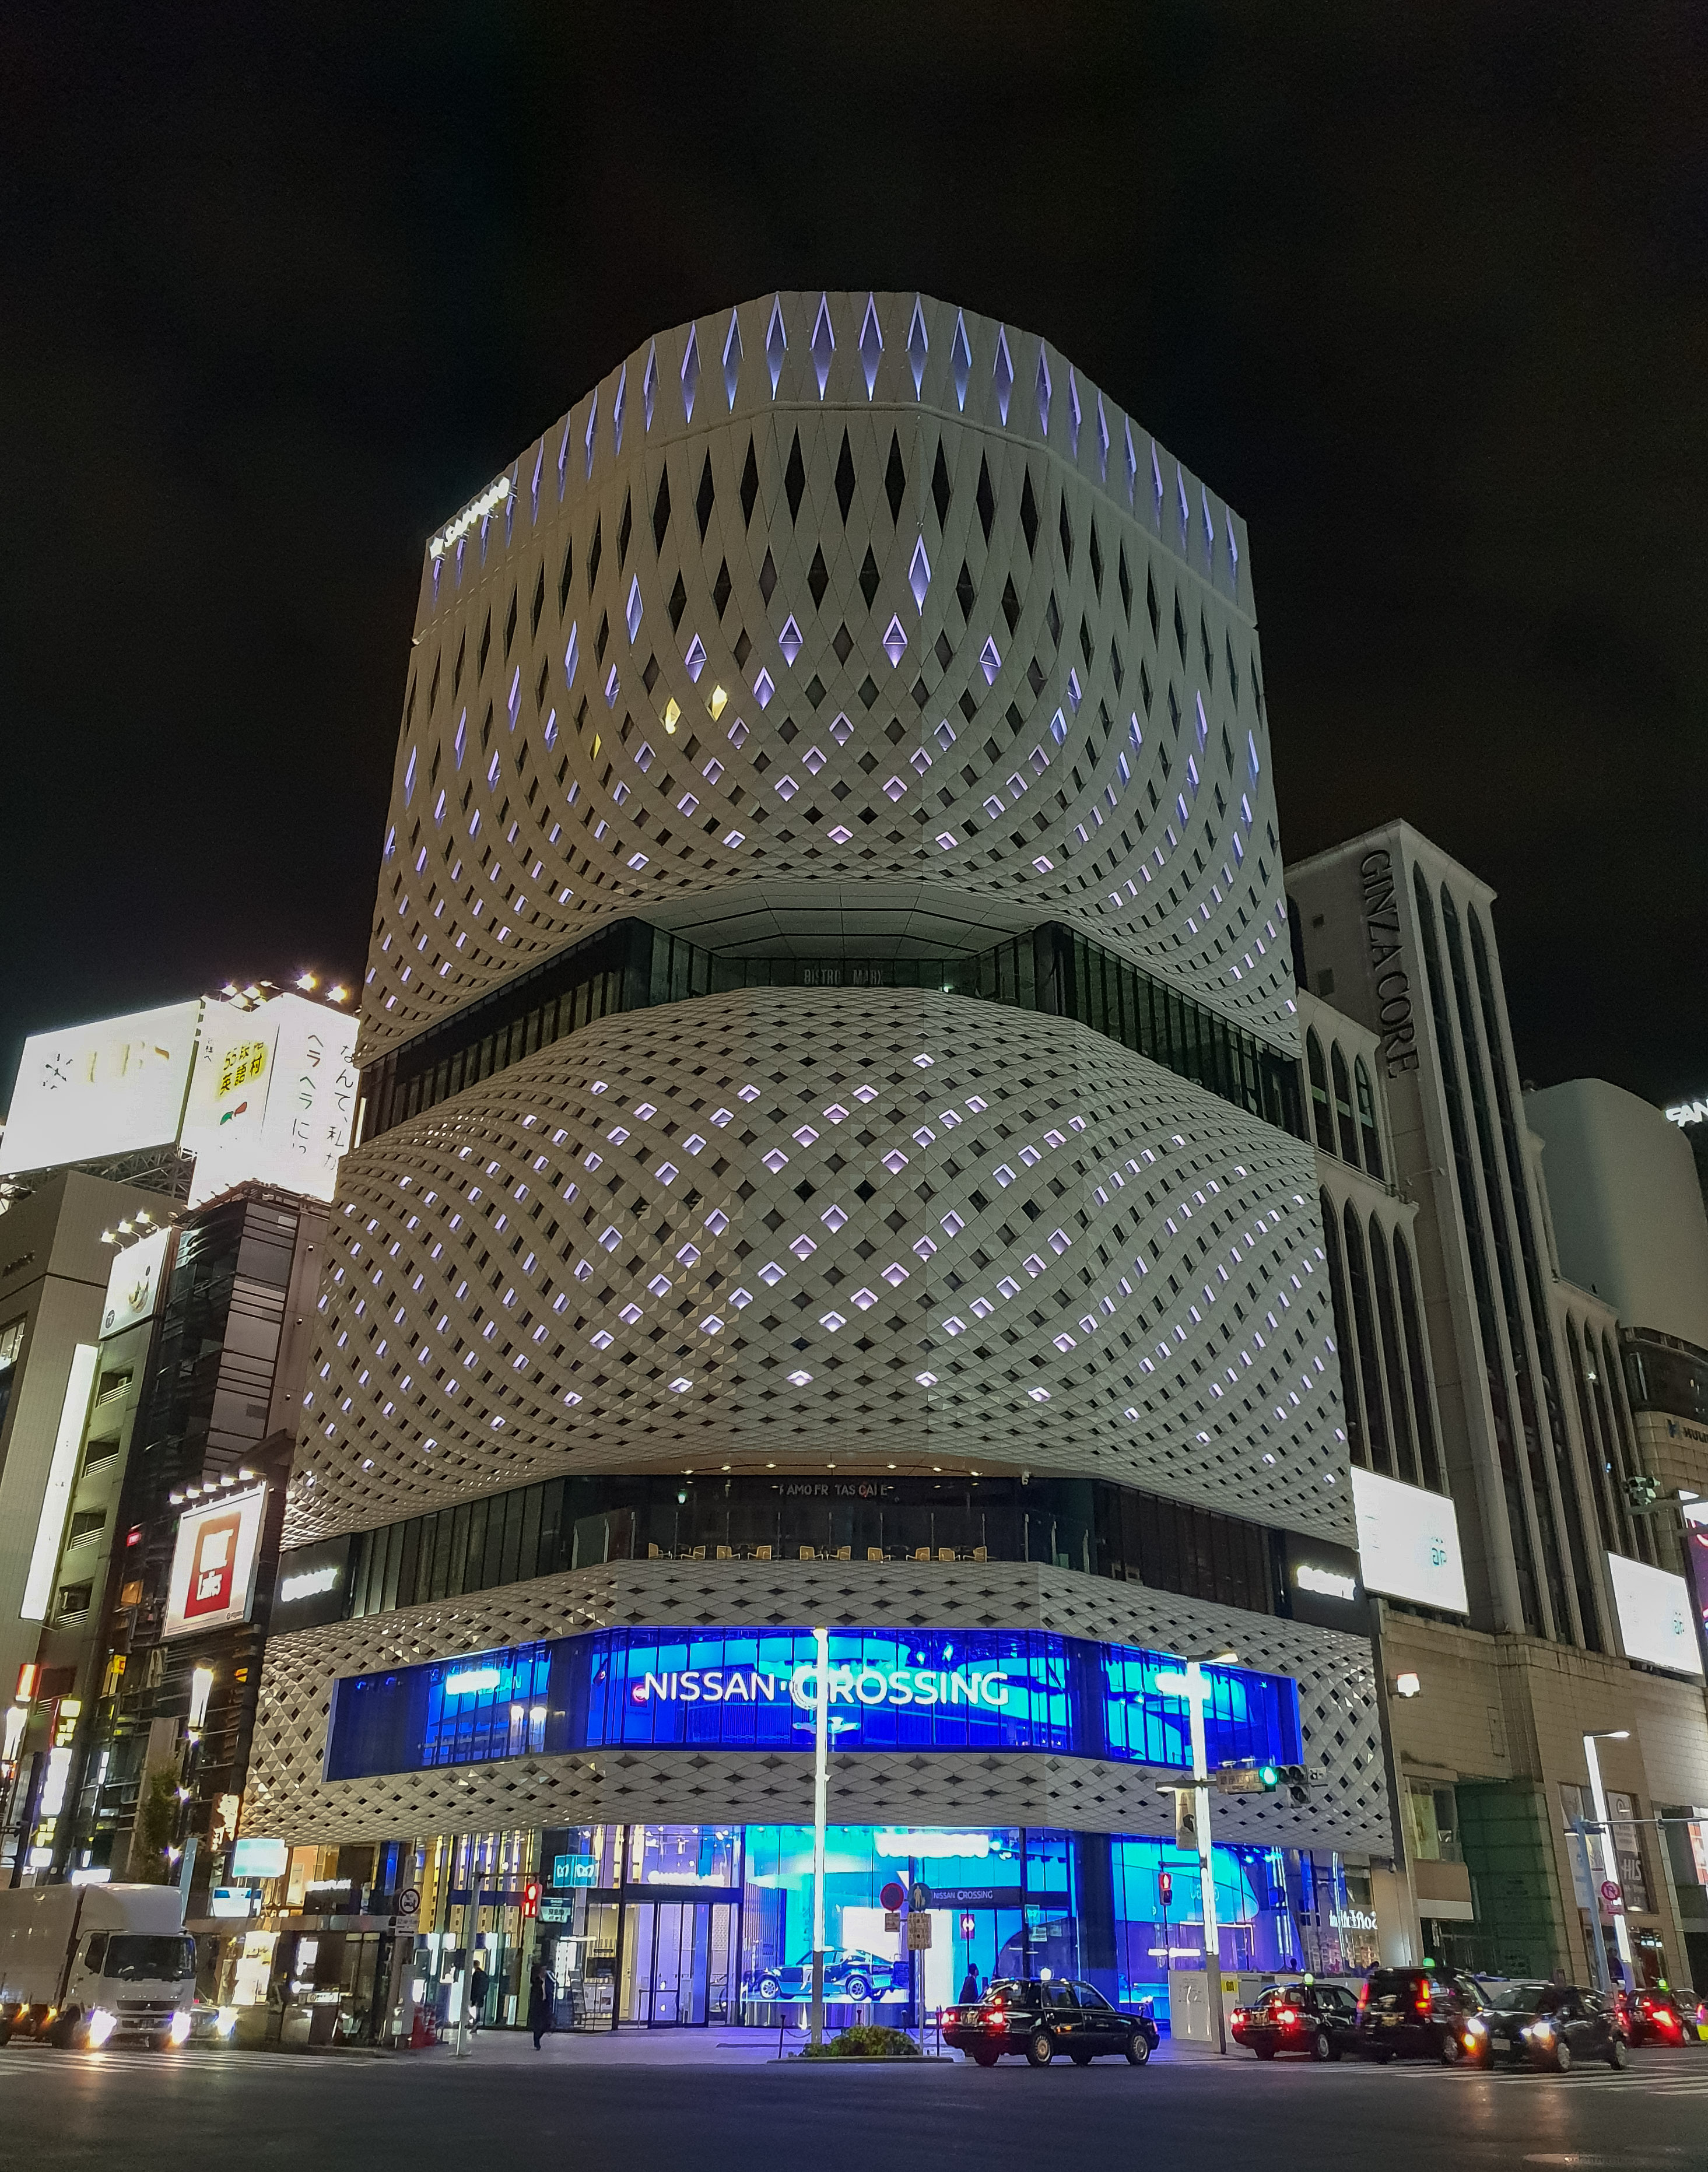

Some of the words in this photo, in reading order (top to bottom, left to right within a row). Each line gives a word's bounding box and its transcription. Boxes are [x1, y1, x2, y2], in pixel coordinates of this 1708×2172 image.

[1360, 849, 1404, 971] GINZA
[1377, 970, 1420, 1079] CORE
[643, 1671, 775, 1701] NISSAN
[790, 1665, 1009, 1710] CROSSING
[933, 1892, 956, 1900] NISSAN
[956, 1890, 993, 1900] CROSSING
